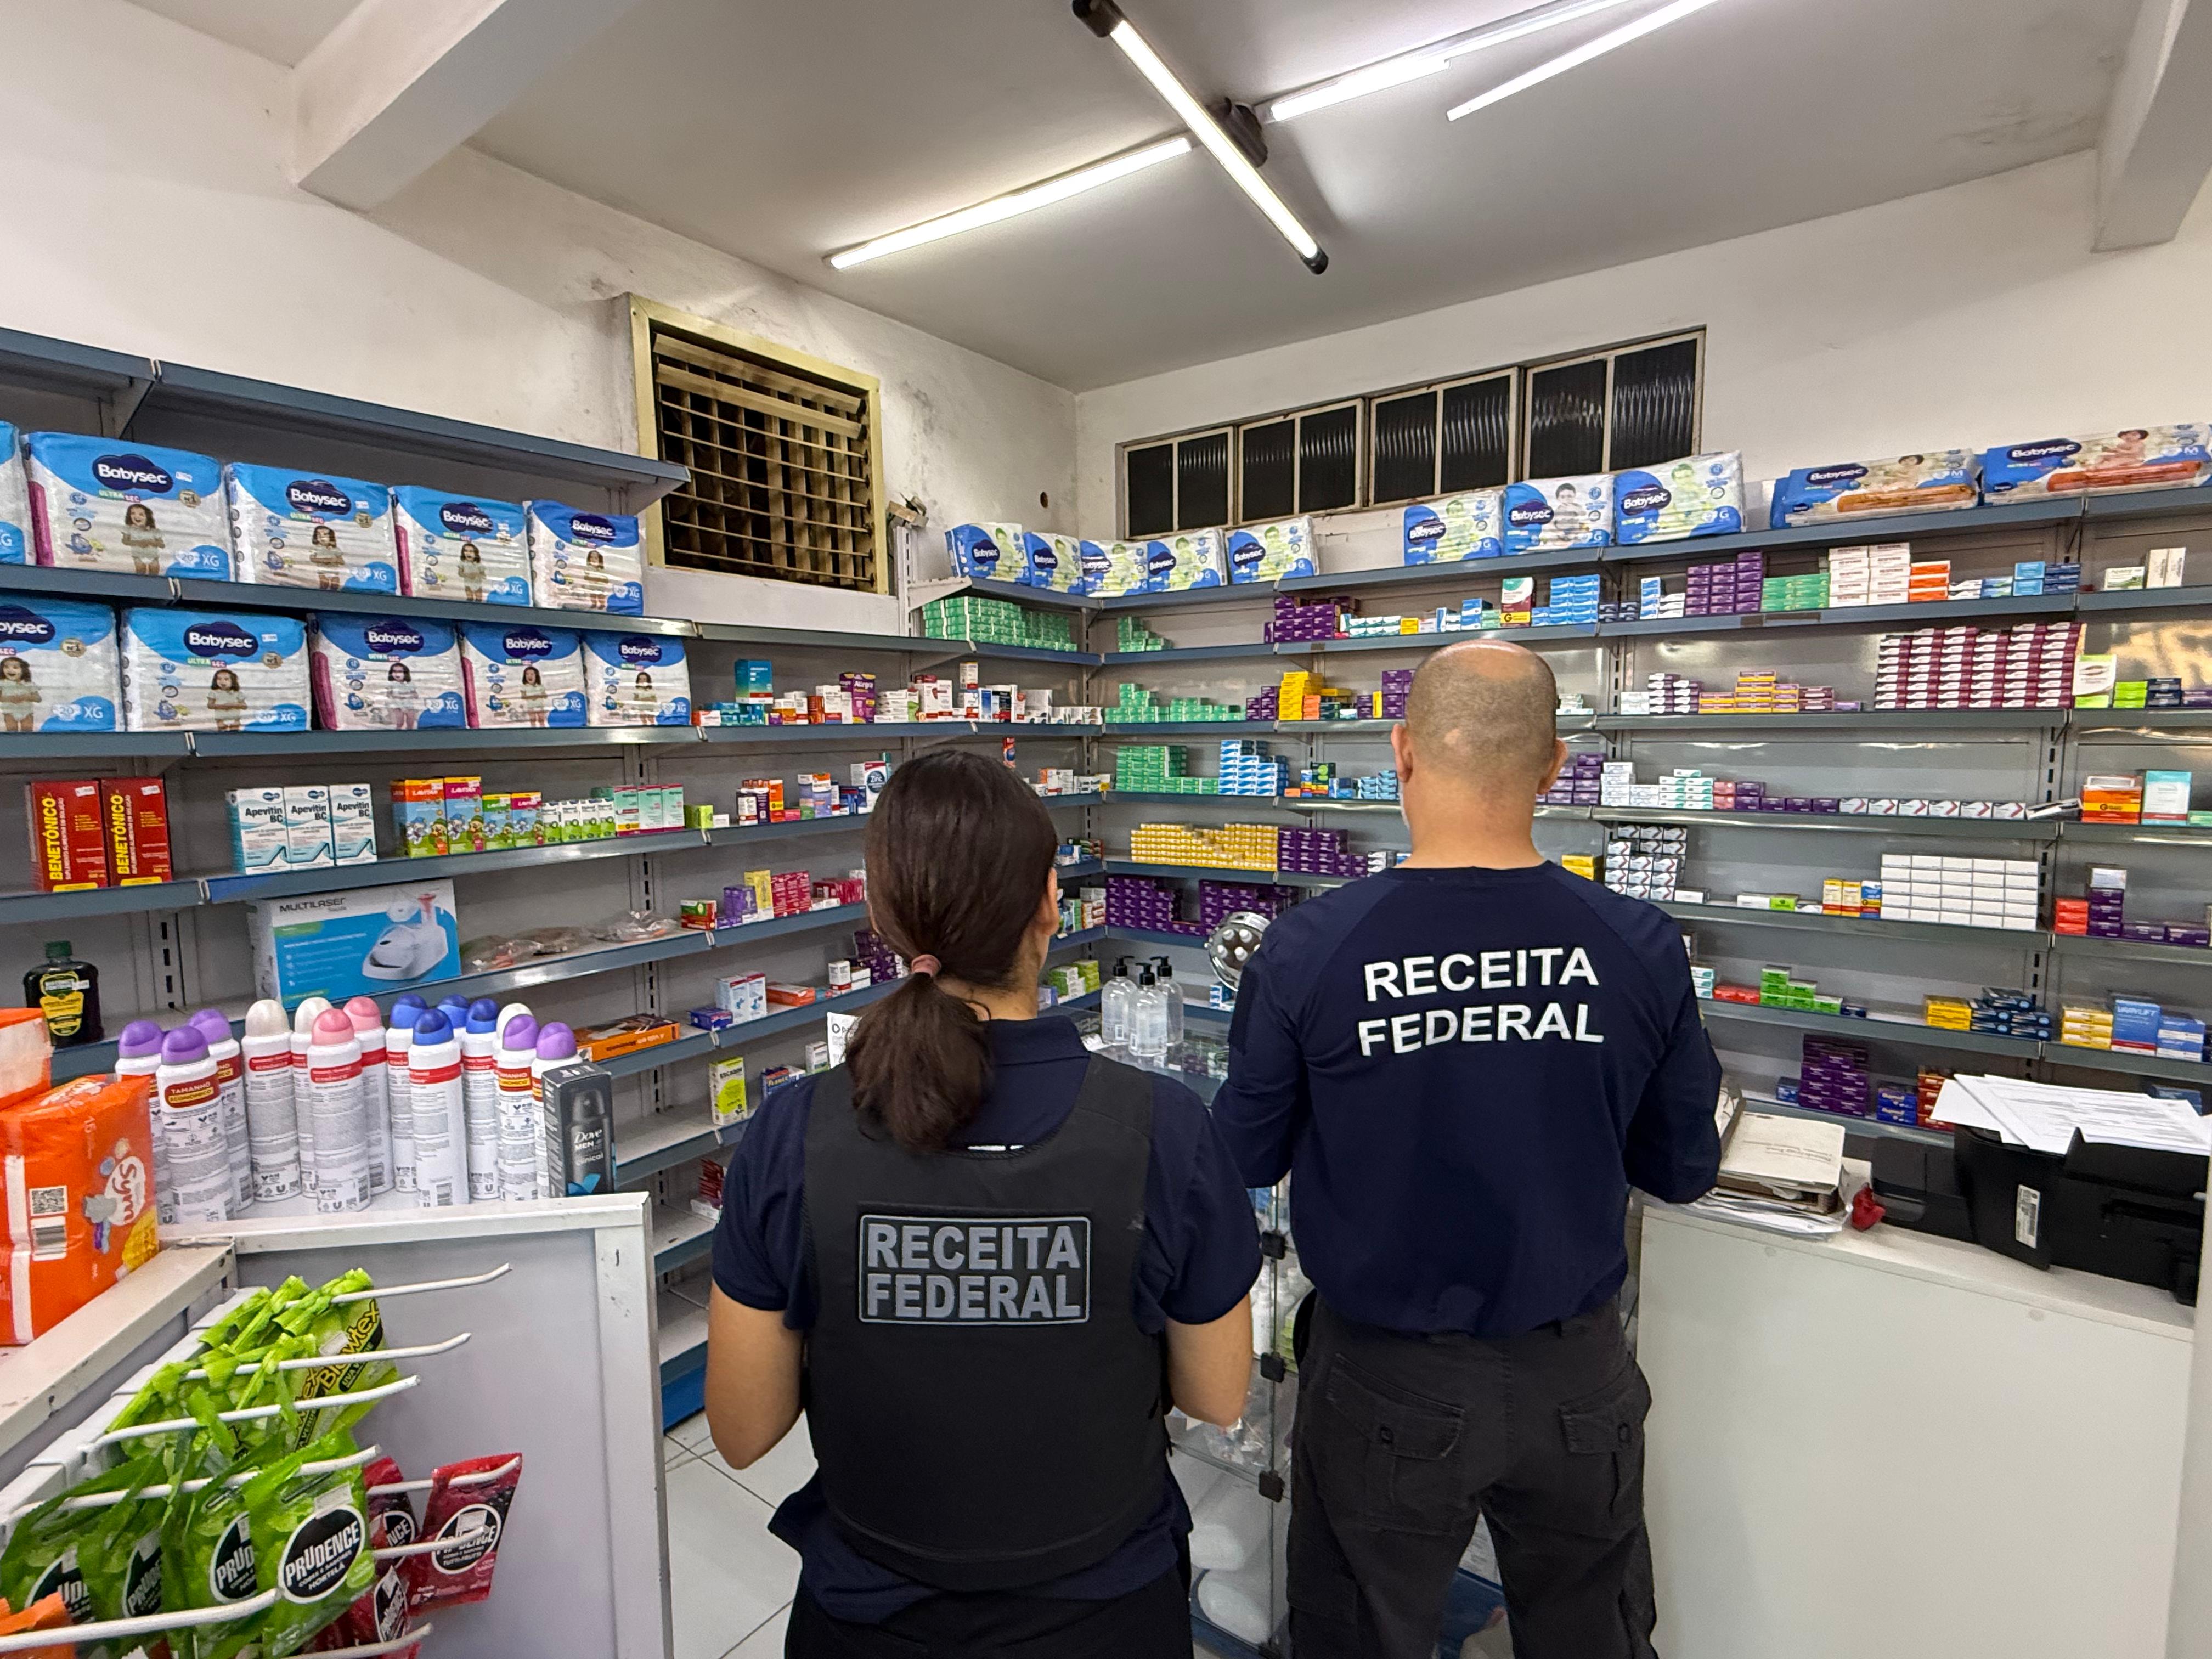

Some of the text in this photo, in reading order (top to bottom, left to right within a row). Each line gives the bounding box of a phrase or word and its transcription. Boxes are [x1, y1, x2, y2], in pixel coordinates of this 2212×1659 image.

[2012, 444, 2075, 458] Babysec
[98, 463, 168, 484] Babysec
[1810, 469, 1863, 481] Babysec
[291, 488, 347, 507] Babysec
[1623, 492, 1668, 510] Babysec
[443, 511, 492, 528] Babysec
[1511, 509, 1551, 521] Babysec
[1719, 510, 1729, 519] G
[573, 519, 613, 537] Babysec
[1409, 524, 1444, 539] Babysec
[0, 533, 12, 546] G
[974, 548, 998, 558] Babysec
[1035, 555, 1056, 564] Babysec
[1234, 548, 1263, 562] Babysec
[201, 553, 219, 567] XG
[1150, 558, 1175, 571] Babysec
[373, 570, 387, 581] XG
[510, 583, 523, 594] XG
[629, 586, 640, 597] XG
[189, 632, 255, 648] Babysec
[368, 631, 420, 645] Babysec
[505, 638, 549, 652] Babysec
[621, 645, 659, 657] Babysec
[444, 699, 459, 710] XG
[570, 699, 582, 709] XG
[677, 703, 687, 713] XG
[84, 707, 103, 718] XG
[279, 712, 297, 723] XG
[245, 806, 283, 817] Apevitin
[291, 804, 327, 815] Apevitin
[337, 802, 370, 811] Apevitin
[358, 809, 370, 817] BC
[270, 815, 284, 823] BC
[314, 812, 327, 821] BC
[1364, 947, 1599, 1002] RECEITA
[1358, 1002, 1604, 1056] FEDERAL
[171, 1081, 211, 1094] TAMANHO
[575, 1128, 603, 1144] Dove
[575, 1140, 595, 1150] MEN
[867, 1223, 1081, 1270] RECEITA
[867, 1273, 1081, 1318] FEDERAL
[285, 1521, 360, 1587] PRUDENCE
[216, 1545, 255, 1590] PRUD
